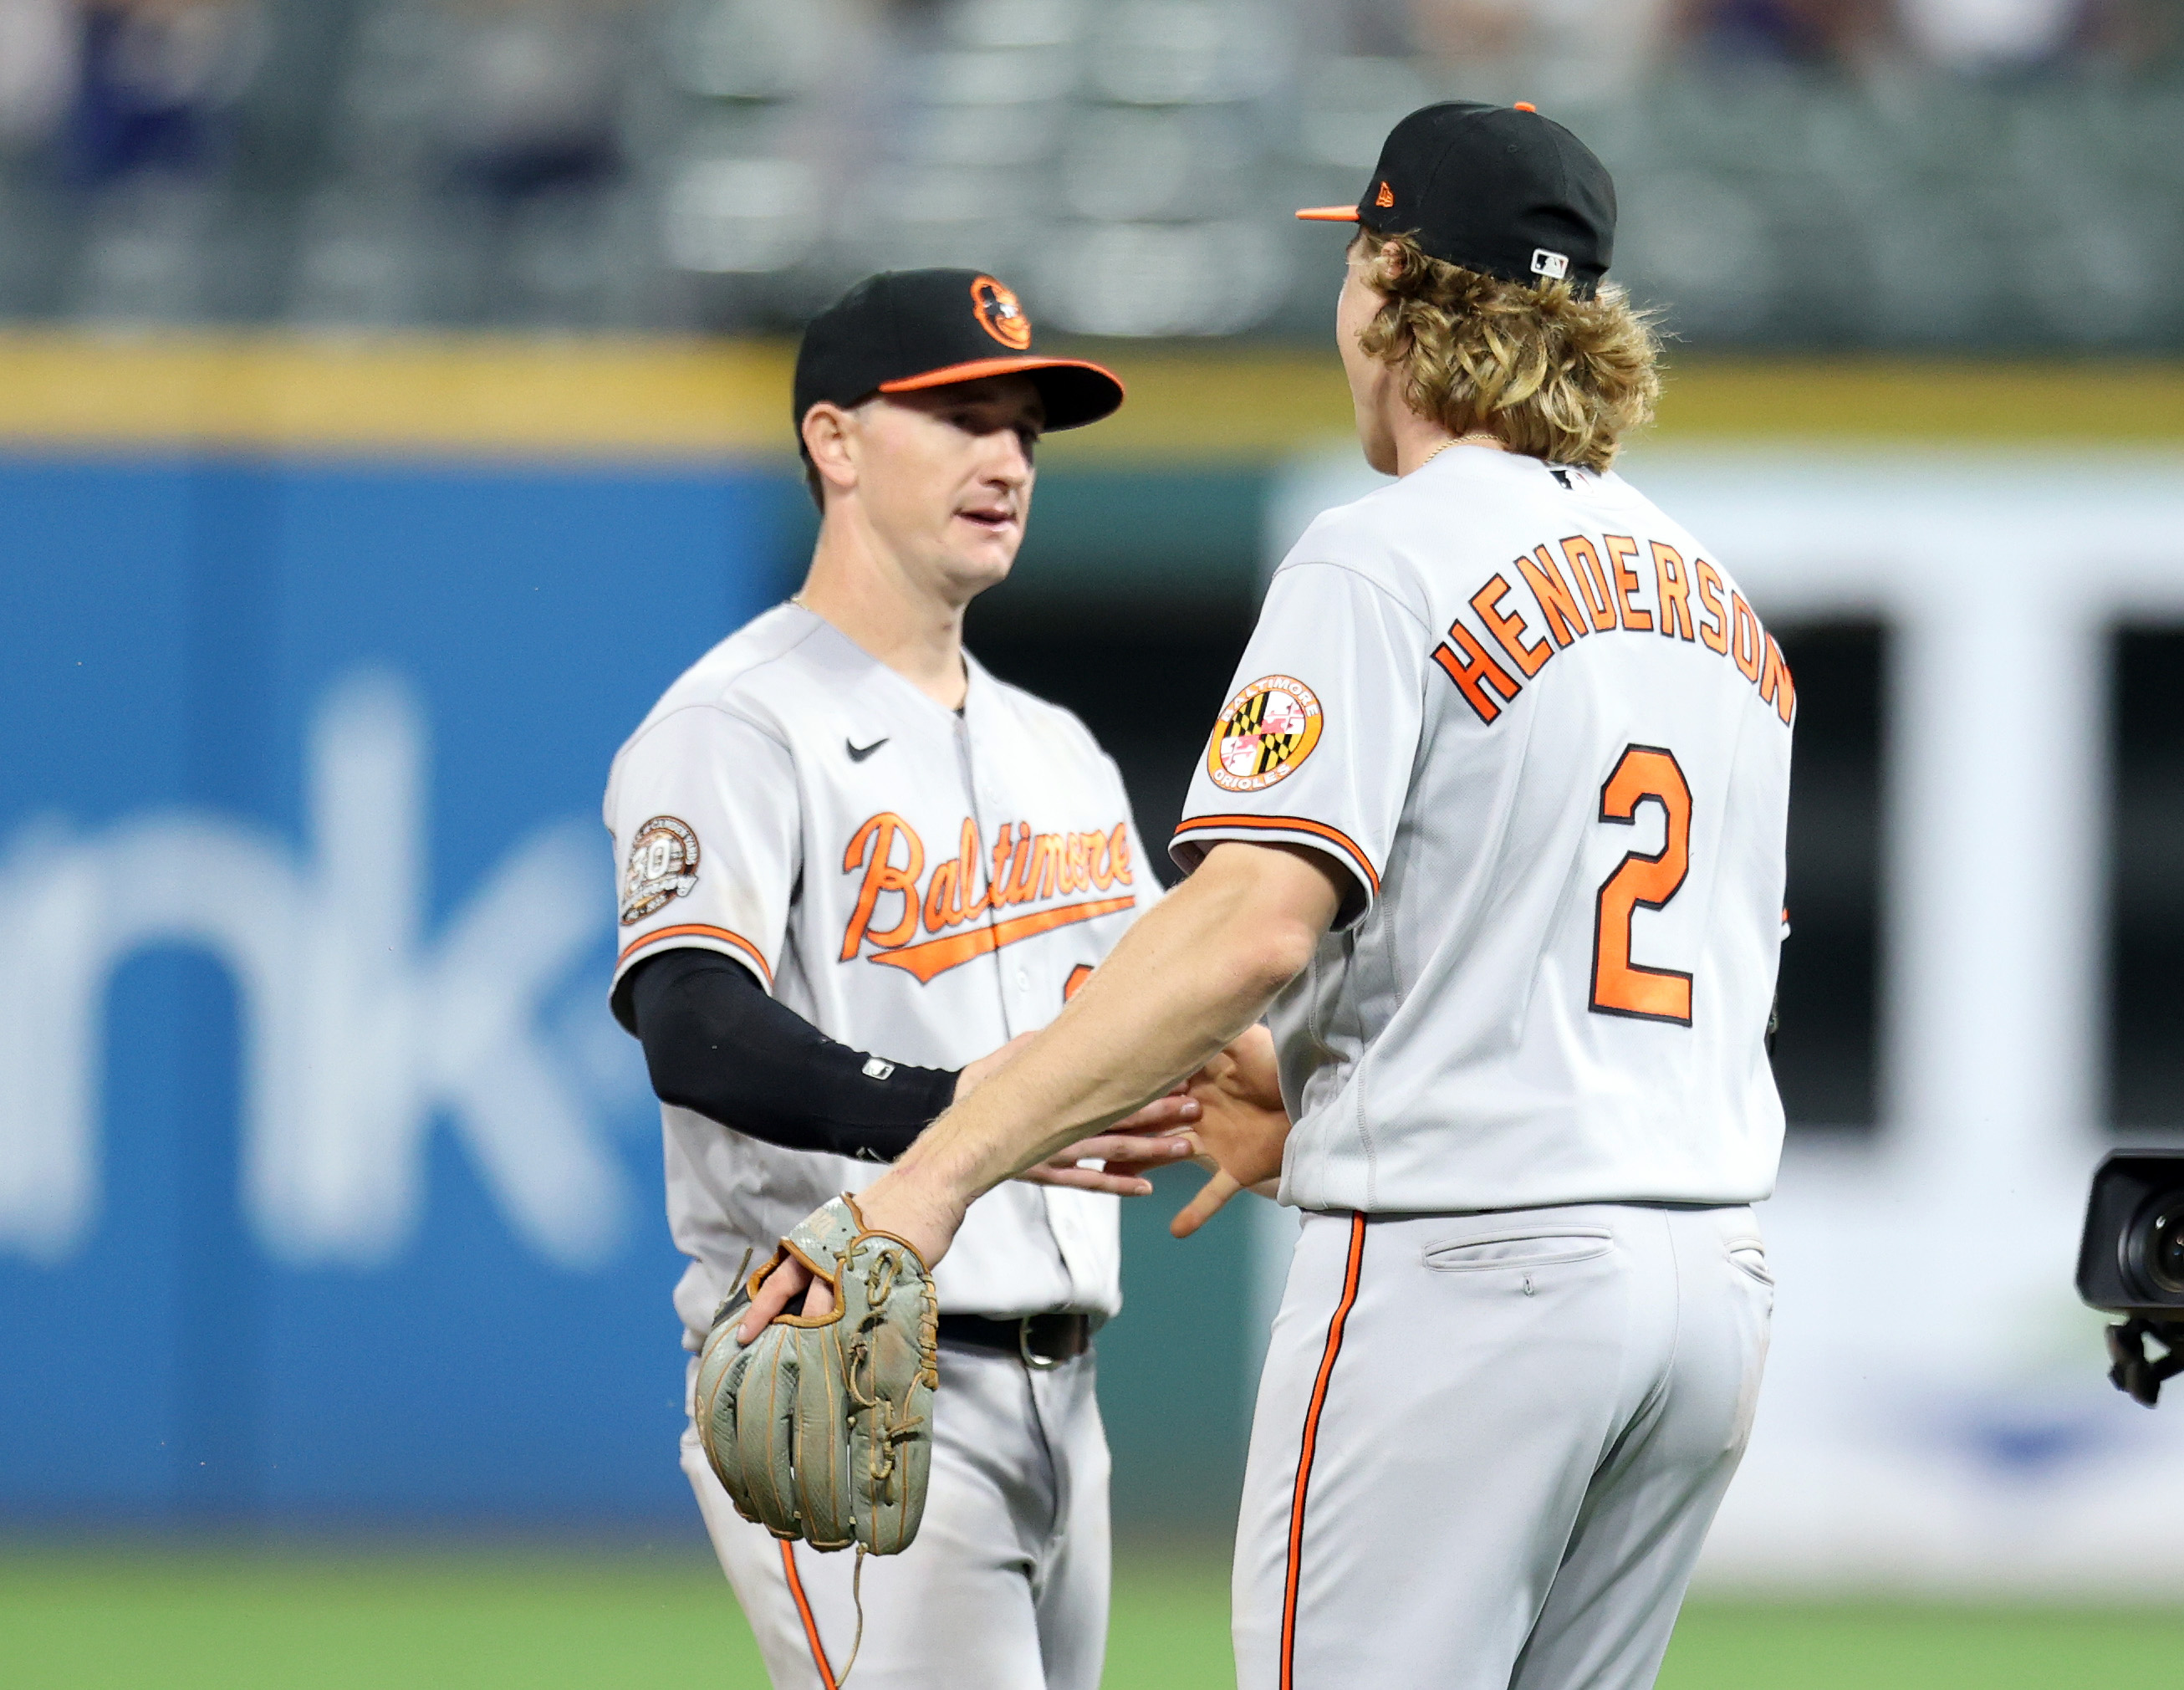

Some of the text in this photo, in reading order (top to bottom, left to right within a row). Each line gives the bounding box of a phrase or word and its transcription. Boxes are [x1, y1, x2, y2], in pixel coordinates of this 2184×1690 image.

[1221, 678, 1319, 722] BALTIMORE
[1429, 534, 1798, 727] HENDERSON
[1212, 763, 1292, 790] ORIOLES
[839, 811, 1133, 961] Baltimore
[1588, 743, 1693, 1027] 2
